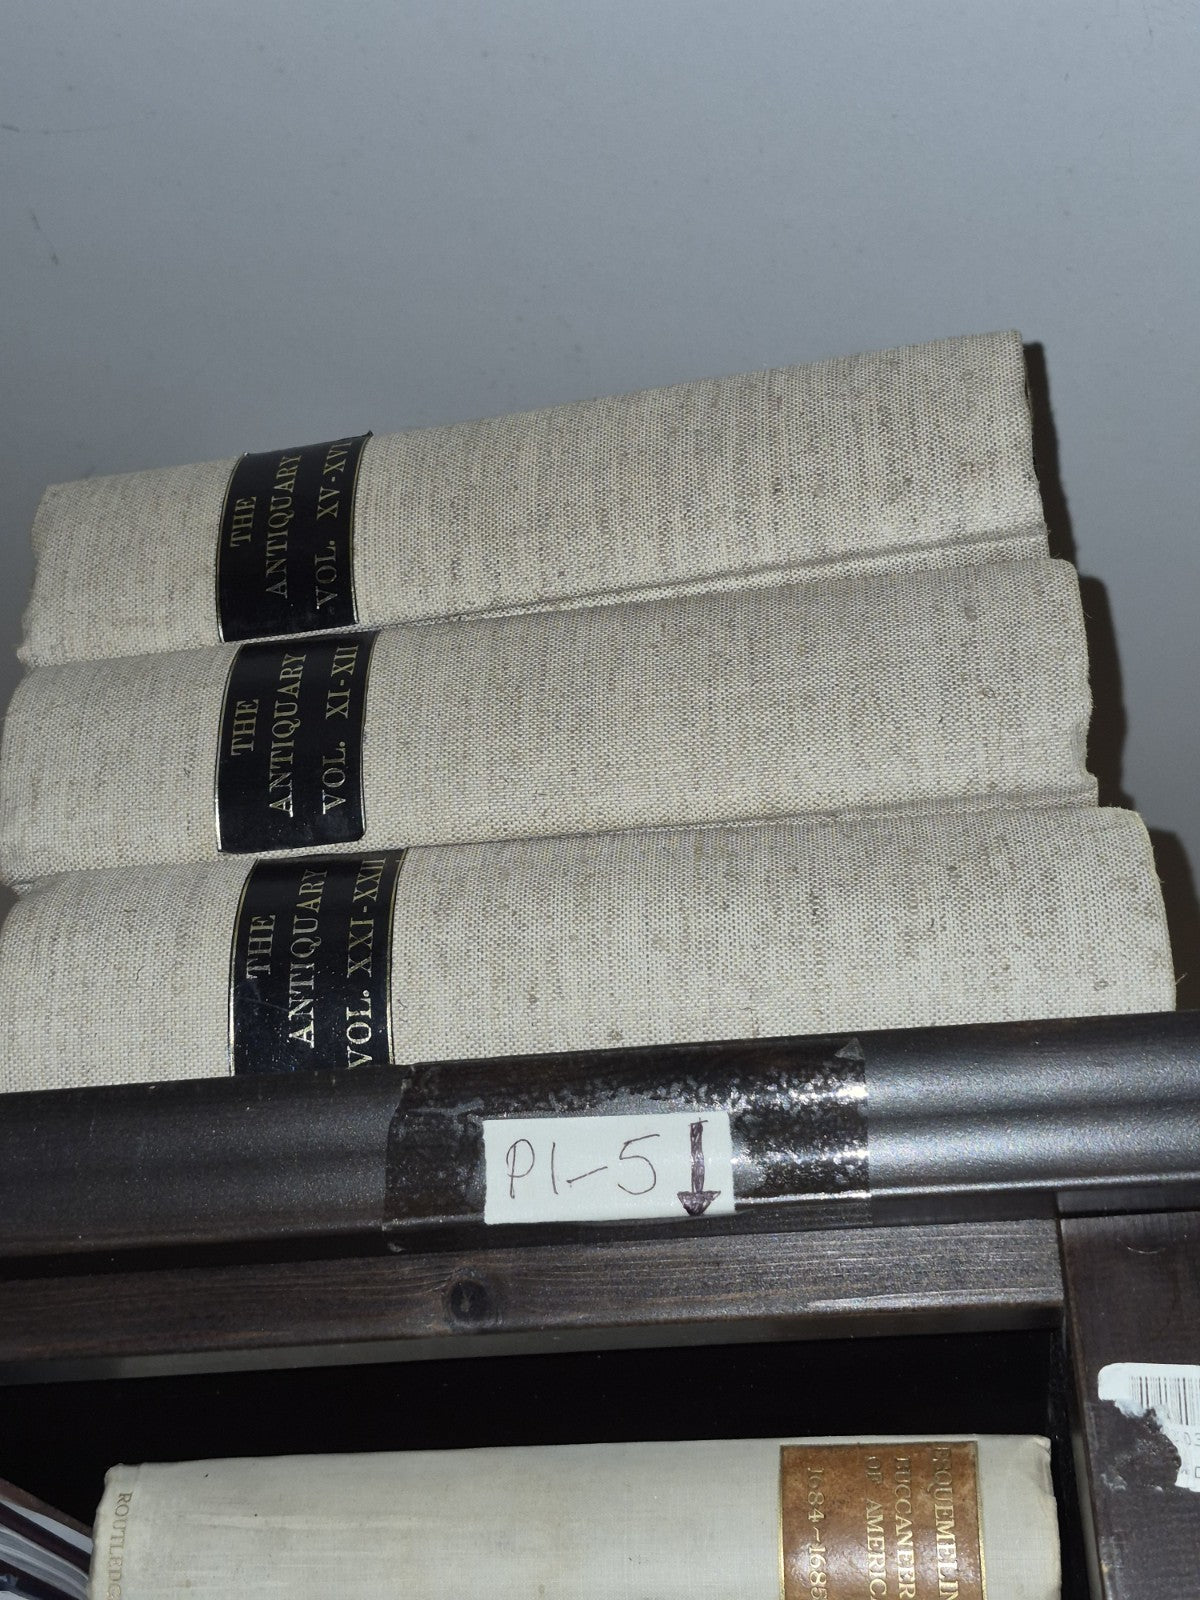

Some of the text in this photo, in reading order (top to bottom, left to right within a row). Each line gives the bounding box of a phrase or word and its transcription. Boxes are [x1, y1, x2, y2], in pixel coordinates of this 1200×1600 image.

[230, 496, 257, 548] THE
[266, 455, 302, 599] ANTIQUARY
[314, 540, 338, 609] VOL.
[230, 698, 259, 756] THE
[269, 653, 306, 818] ANTIQUARY
[321, 740, 346, 815] VOL.
[246, 914, 276, 980] THE
[288, 868, 328, 1049] ANTIQUARY
[345, 989, 373, 1069] VOL.
[865, 1456, 888, 1600] OF AMERIC
